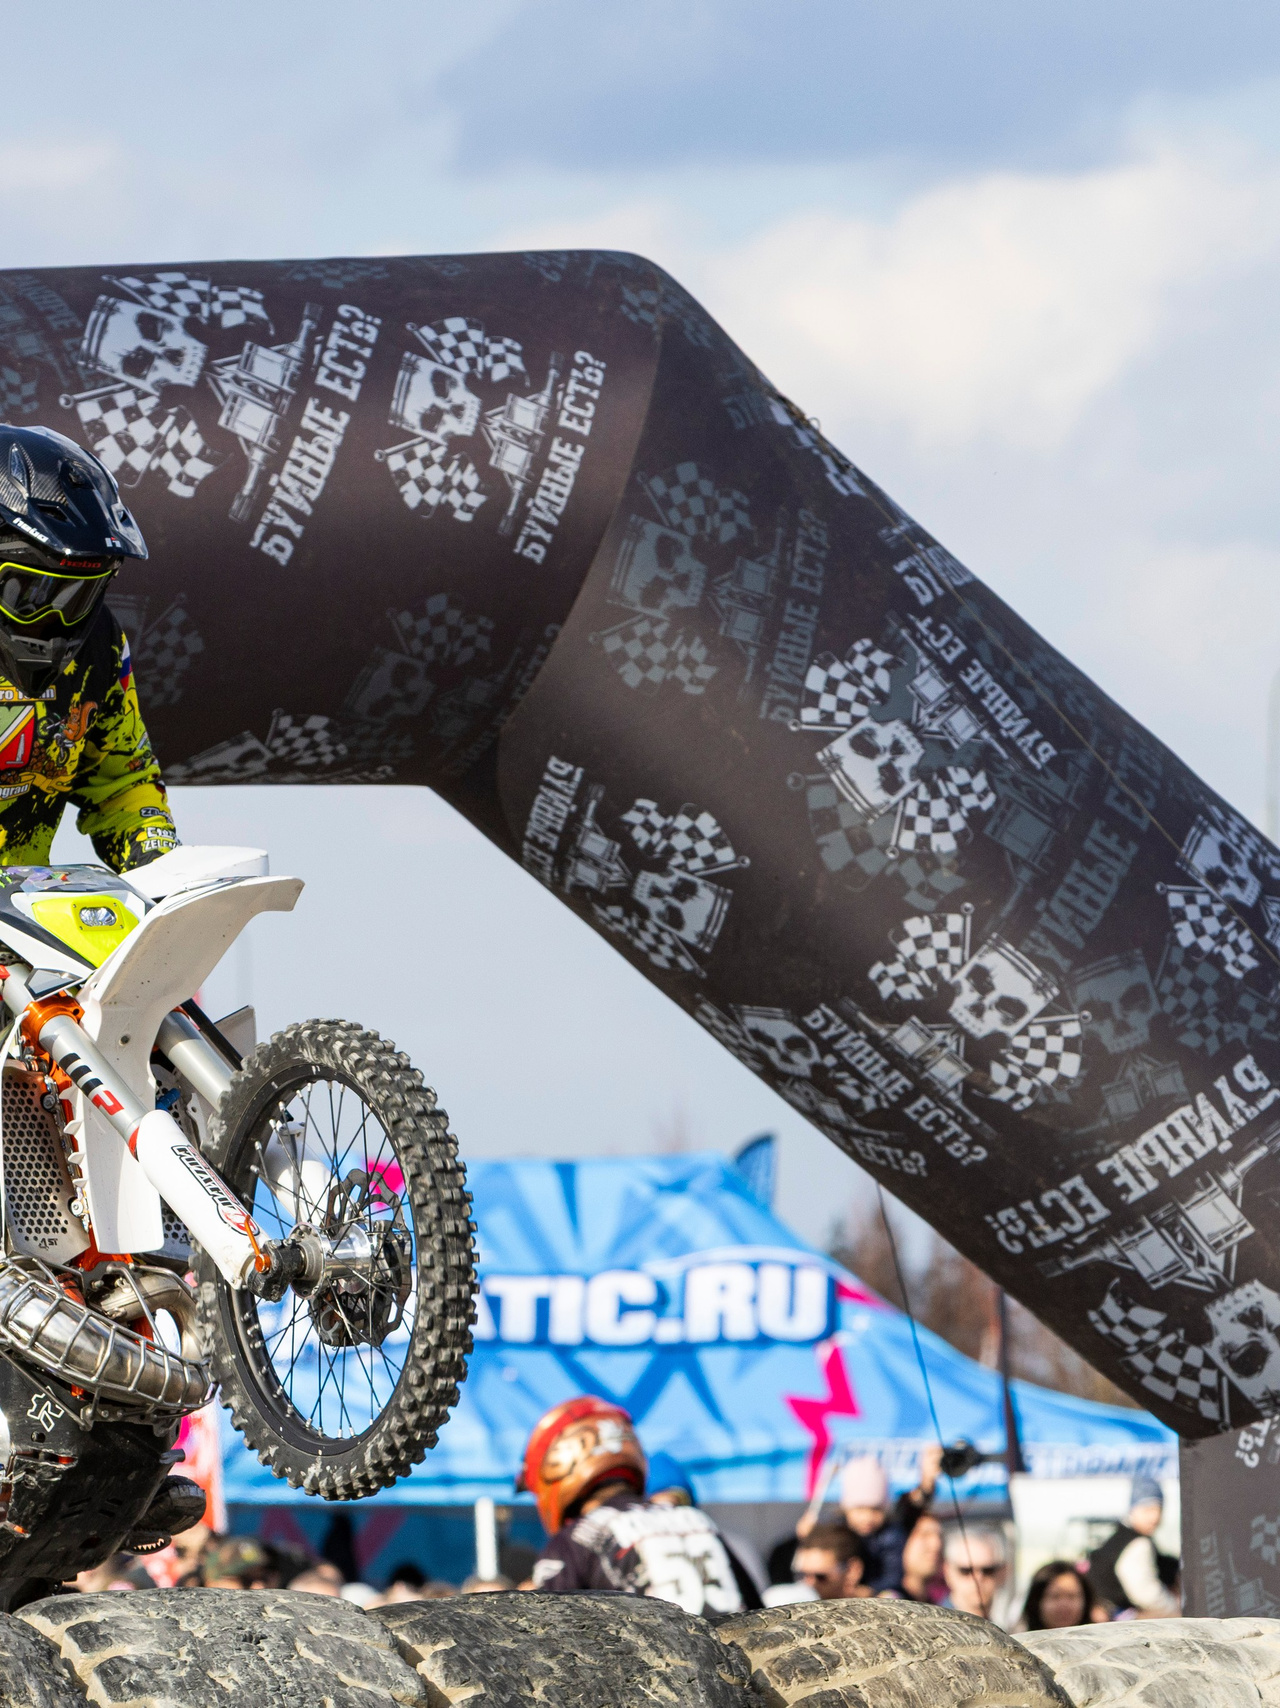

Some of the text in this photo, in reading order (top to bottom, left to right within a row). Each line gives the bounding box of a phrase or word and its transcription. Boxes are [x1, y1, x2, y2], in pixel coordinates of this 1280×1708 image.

[249, 303, 382, 567] БУЙНЫЕ ЕСТЬ?
[513, 436, 586, 565] БУЙНЫЕ
[558, 350, 607, 437] ЕСТЬ?
[18, 687, 54, 699] Tm
[1018, 818, 1140, 975] УЙНЫЕ
[802, 1003, 988, 1167] БУЙНЫЕ ЕСТЬ?
[983, 1053, 1280, 1254] БУЙНЫЕ ЕСТЬ?
[472, 1263, 825, 1346] TIC.RU
